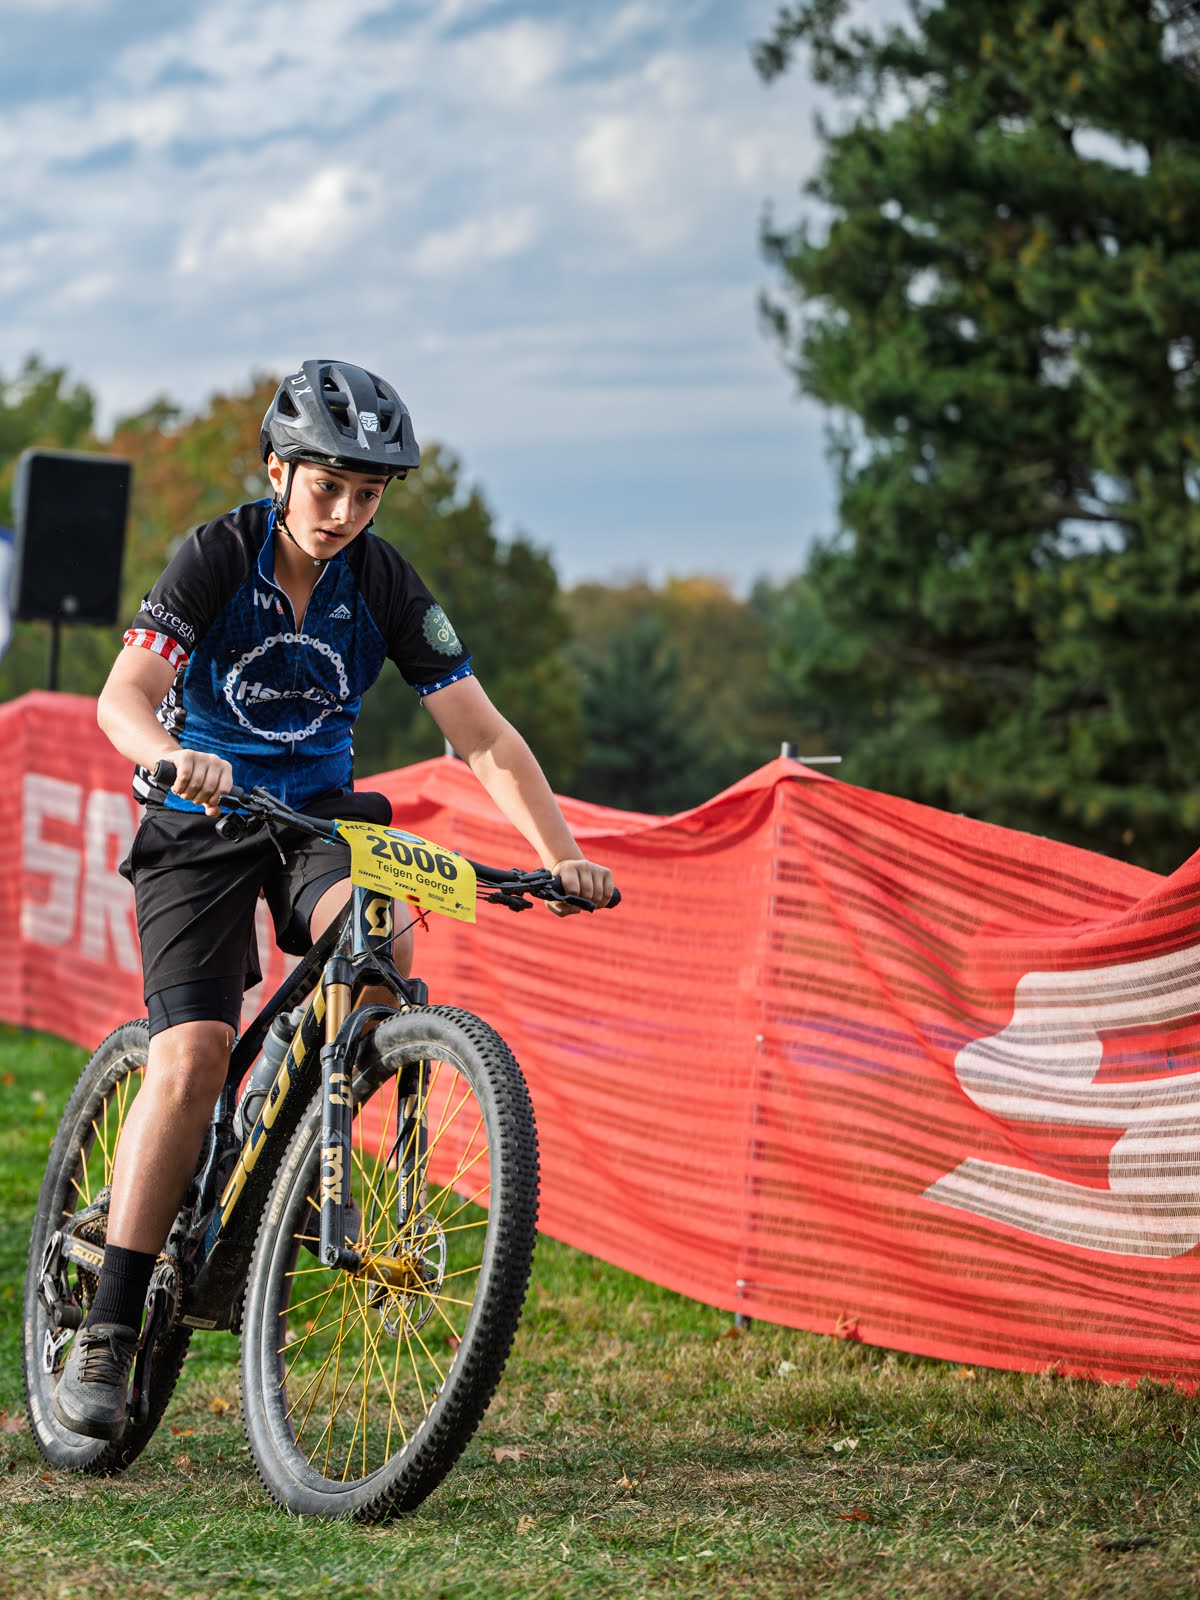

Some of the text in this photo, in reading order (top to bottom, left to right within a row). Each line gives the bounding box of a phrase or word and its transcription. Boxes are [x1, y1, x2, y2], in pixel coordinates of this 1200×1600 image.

[328, 612, 353, 620] AGILE
[345, 824, 376, 833] NICA
[366, 835, 458, 881] 2006
[357, 869, 382, 880] SRAM
[376, 860, 455, 894] Teigen George
[393, 881, 418, 893] TREK
[220, 971, 327, 1228] SCOTT
[321, 1145, 344, 1208] FOX
[400, 1176, 408, 1211] FACTORY
[70, 1243, 105, 1269] SCOTT
